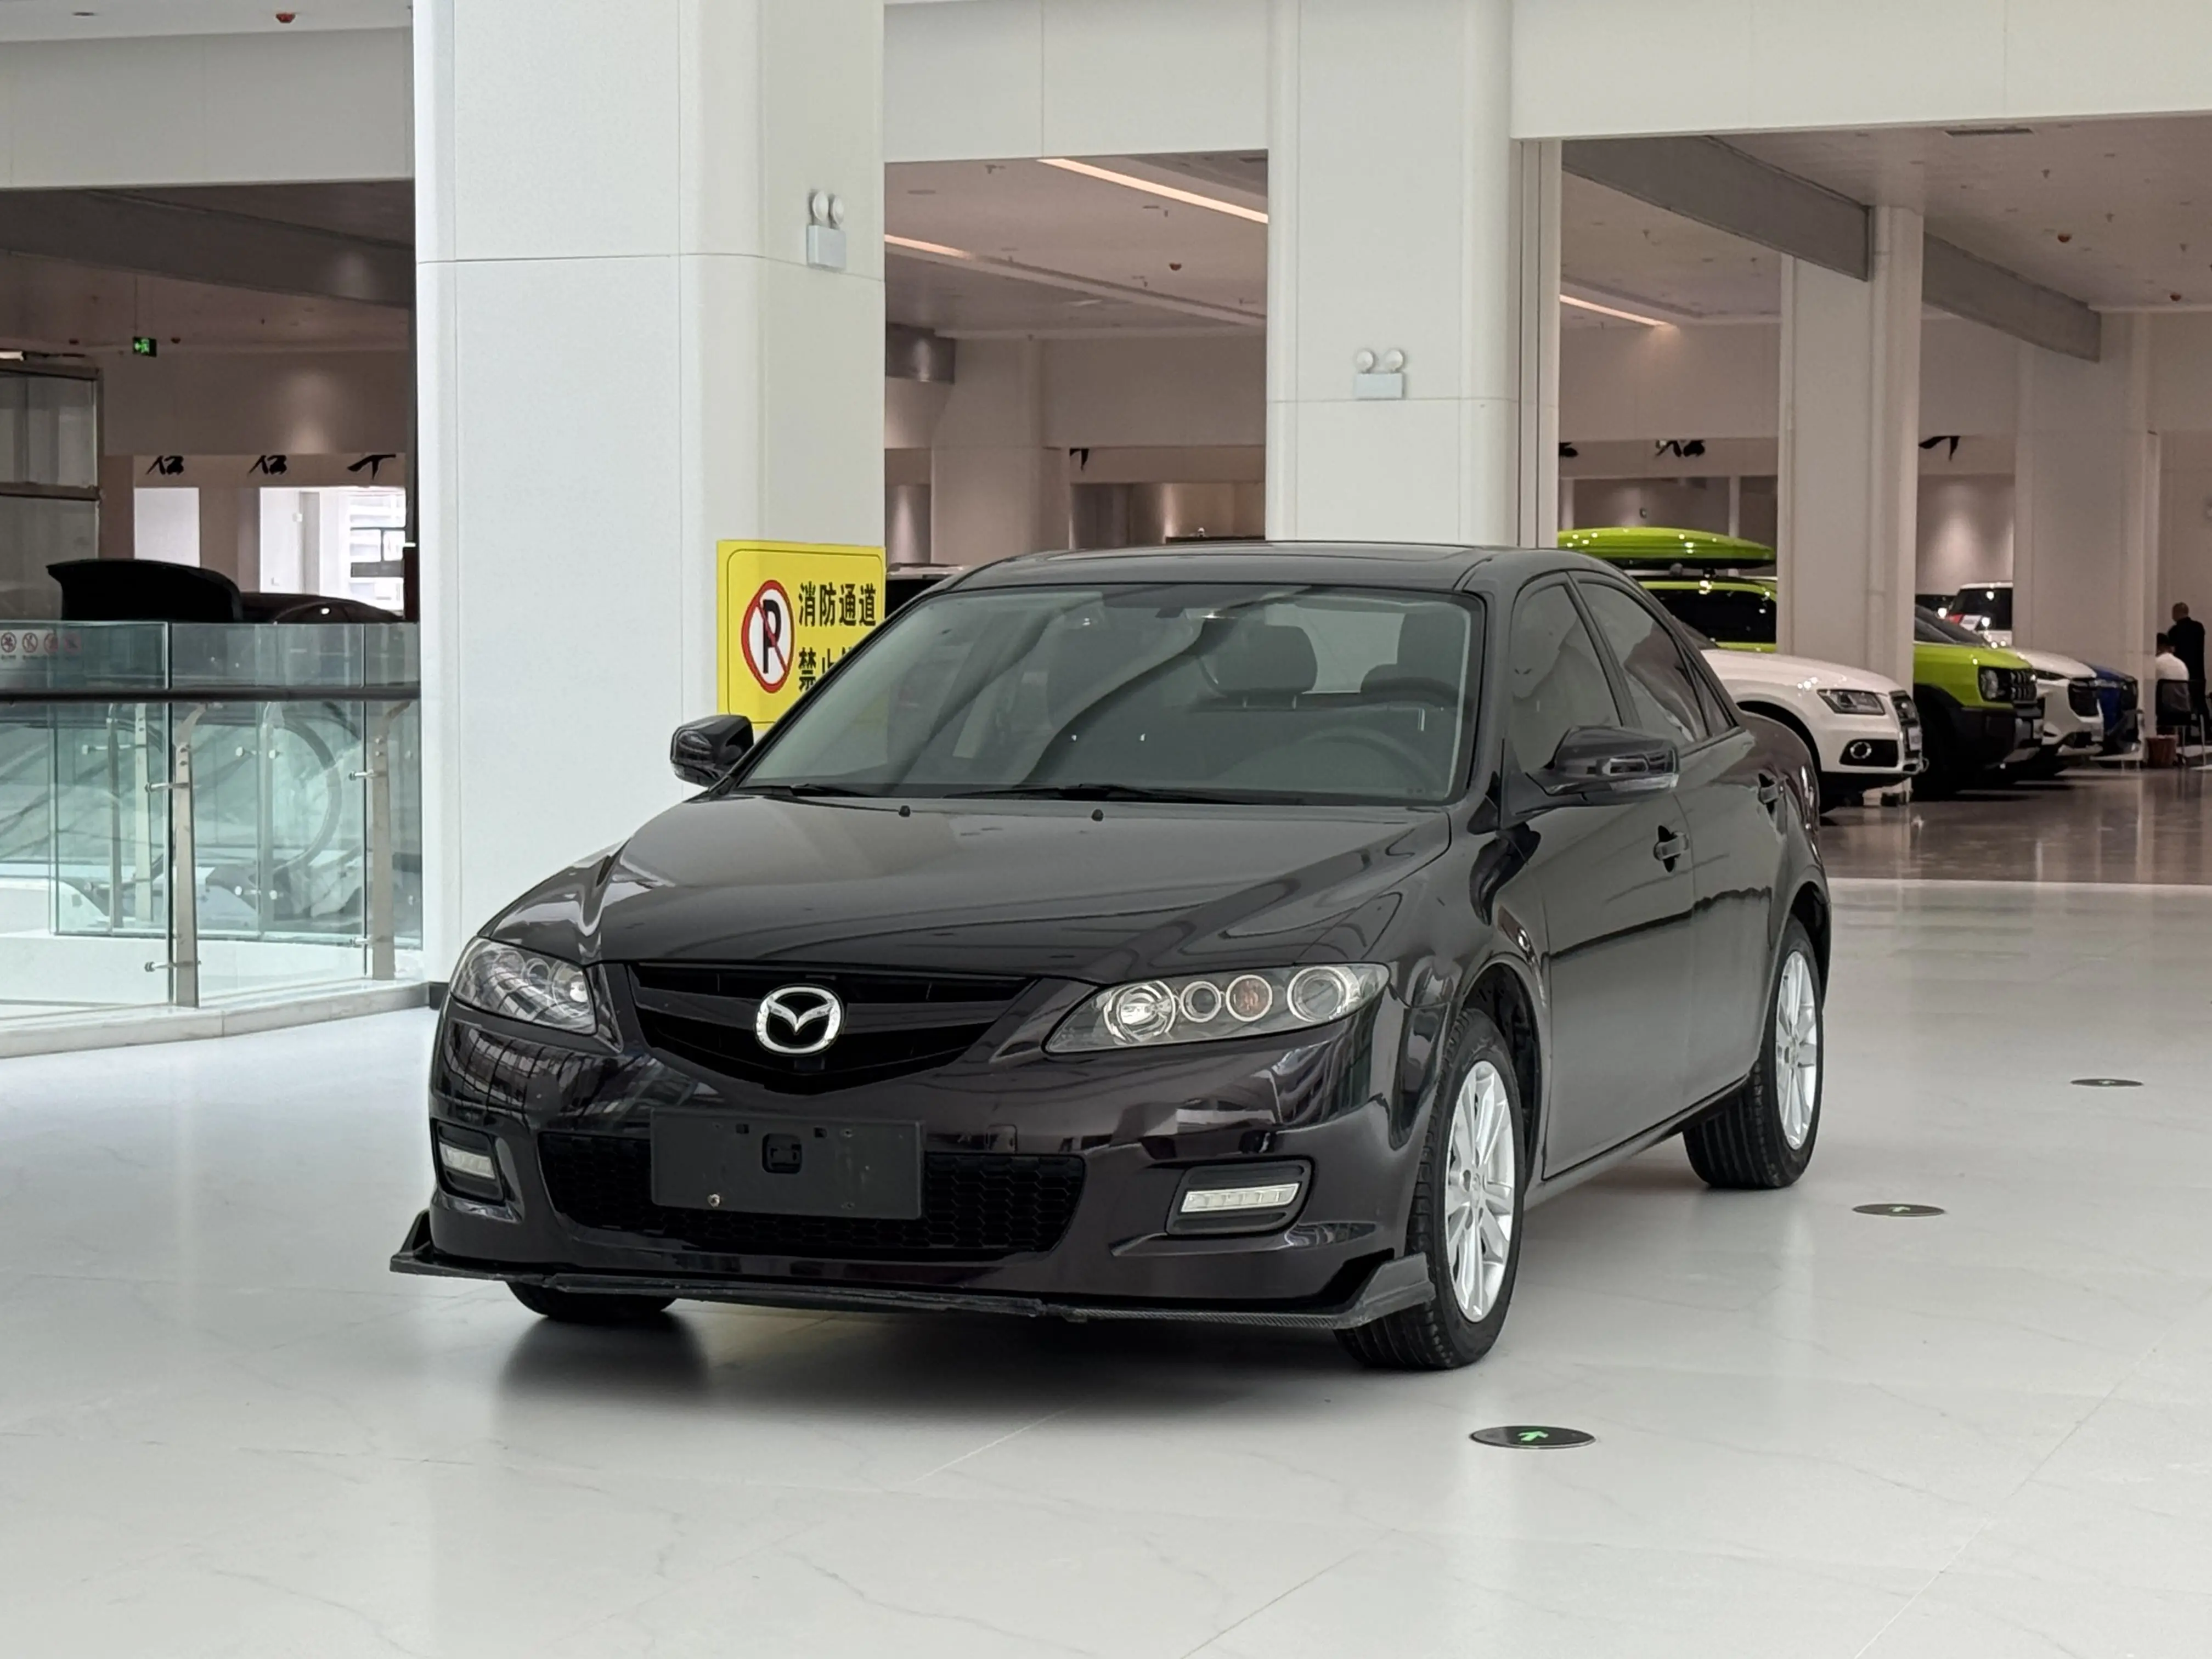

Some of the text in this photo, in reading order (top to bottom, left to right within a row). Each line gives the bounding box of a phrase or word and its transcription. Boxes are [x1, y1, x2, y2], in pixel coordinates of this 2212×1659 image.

[798, 582, 876, 627] 消防通道
[798, 647, 853, 692] 禁止
